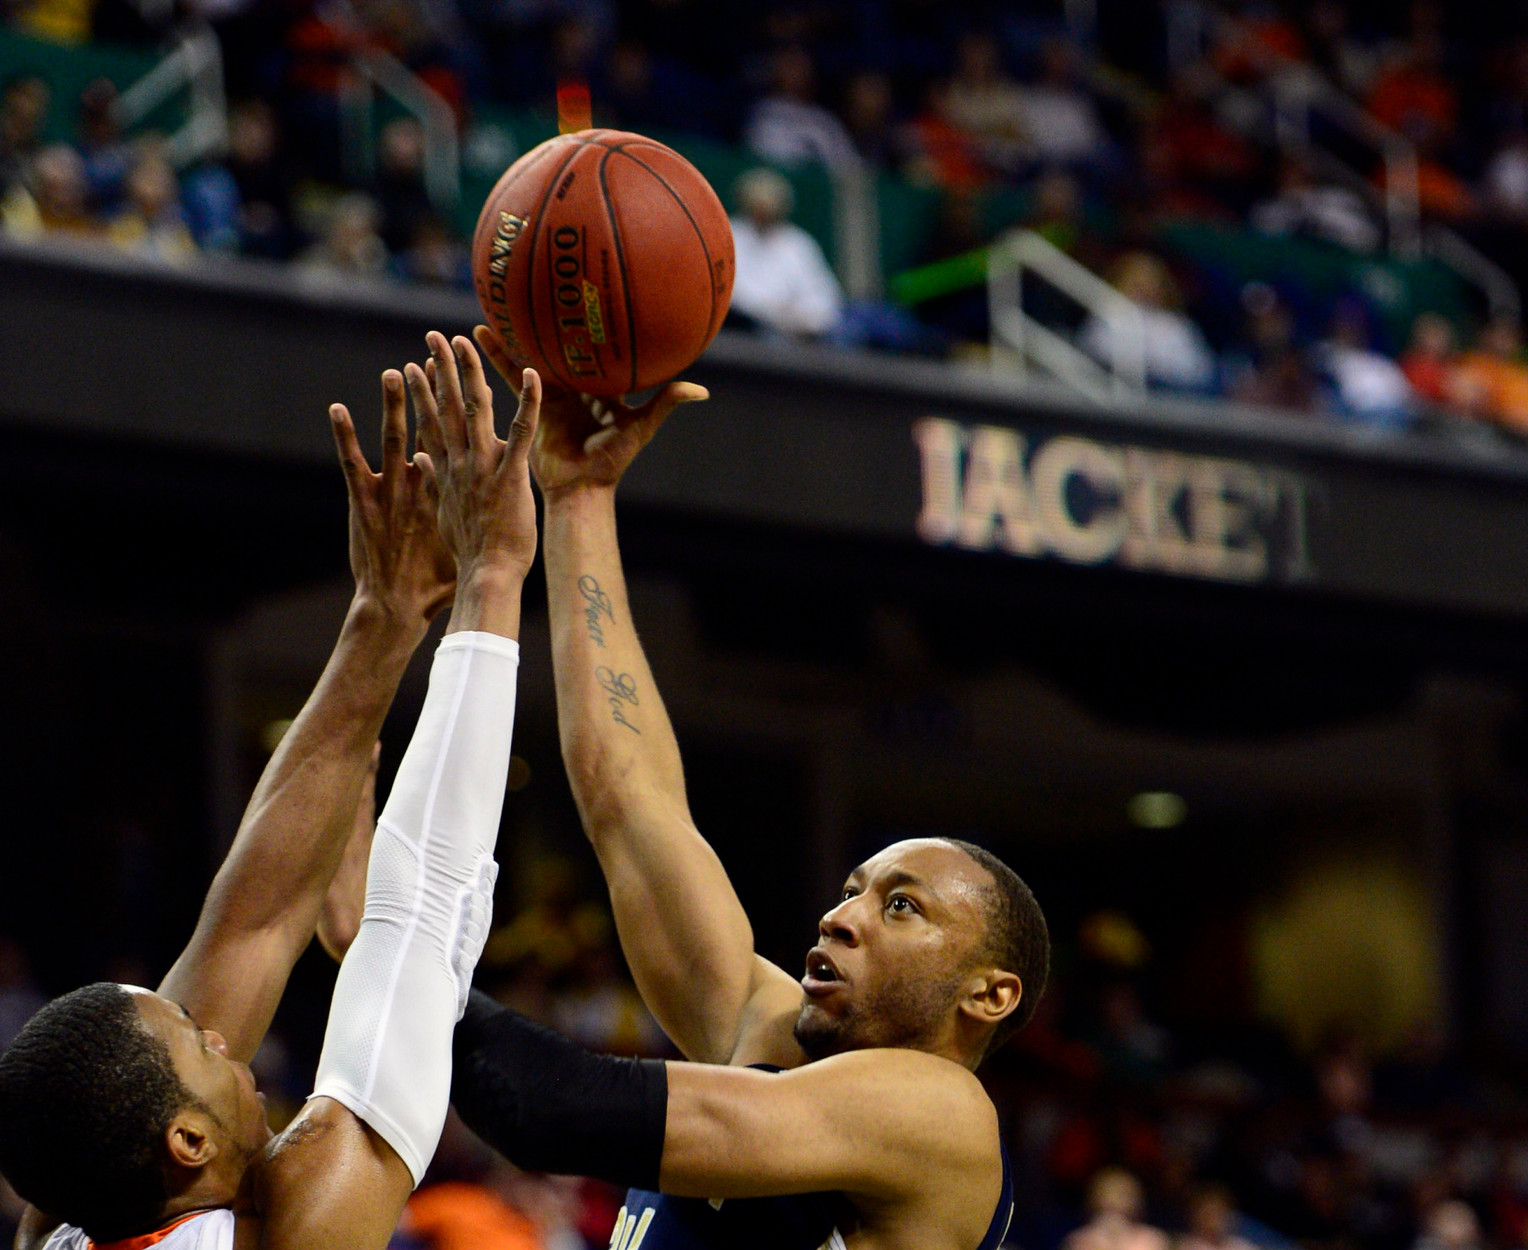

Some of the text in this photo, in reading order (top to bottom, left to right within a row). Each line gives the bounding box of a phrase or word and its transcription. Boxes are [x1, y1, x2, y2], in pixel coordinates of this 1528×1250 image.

[553, 226, 599, 377] TF-1000
[577, 574, 641, 736] Fear God
